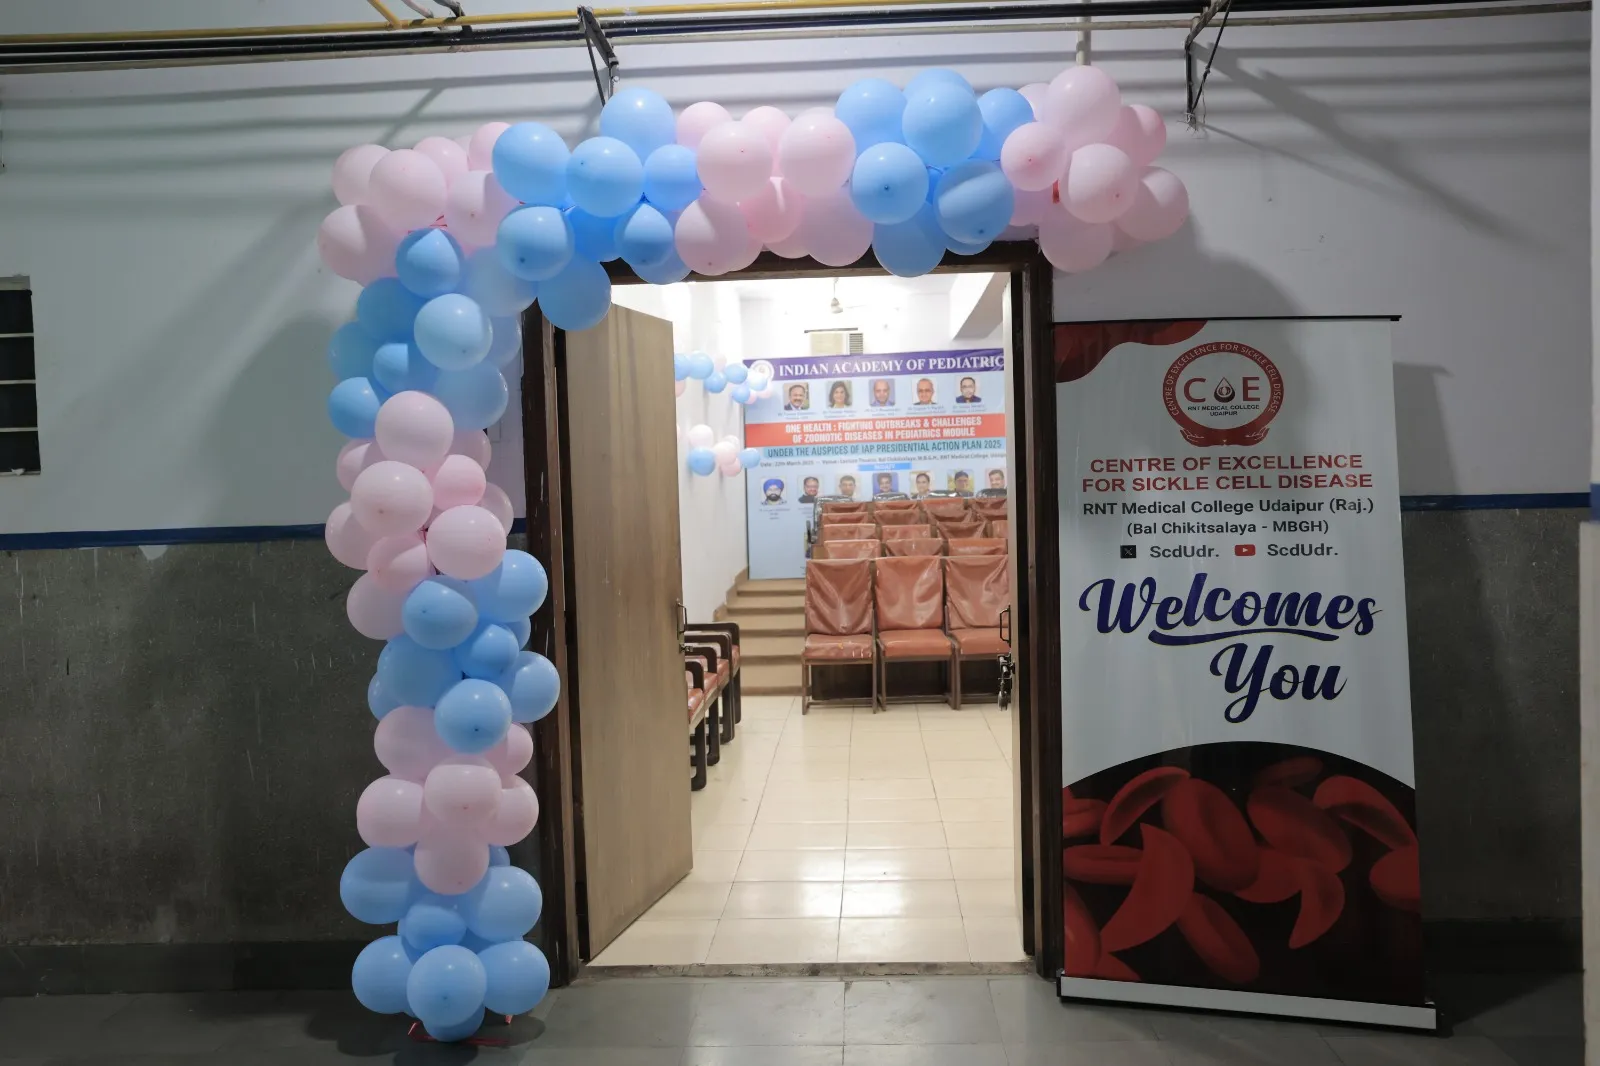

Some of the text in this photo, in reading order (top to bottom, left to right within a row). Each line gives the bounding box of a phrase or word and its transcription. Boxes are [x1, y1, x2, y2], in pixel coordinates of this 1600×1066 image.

[779, 355, 1004, 377] INDIAN ACADEMY OF PEDIATRIC
[1165, 343, 1281, 416] CENTRE OF EXCELLENCE FOR SICKLE CELL DISEASE
[785, 424, 801, 433] ONE
[803, 422, 832, 432] HEALTH
[838, 420, 873, 431] FIGHTING
[875, 419, 921, 430] OUTBREAKS
[923, 418, 930, 428] &
[931, 416, 982, 428] CHALLENGES
[793, 426, 976, 443] OF ZOONOTIC DISEASES IN PEDIATRICS MODULE
[768, 439, 1002, 458] UNDER THE AUSPICES OF IAP PRESIDENTIAL ACTION PLAN 2025
[1090, 455, 1363, 473] CENTRE OF EXCELLENCE
[1082, 473, 1373, 492] FOR SICKLE CELL DISEASE
[1083, 498, 1374, 515] RNT Medical College Udaipur (Raj.)
[1127, 522, 1157, 537] (Bal
[1161, 521, 1257, 535] Chikitsalaya
[1273, 520, 1329, 534] MBGH)
[1150, 544, 1220, 558] ScdUdr.
[1267, 543, 1339, 557] ScdUdr.
[1078, 572, 1383, 636] Welcomes
[1209, 642, 1348, 724] You
